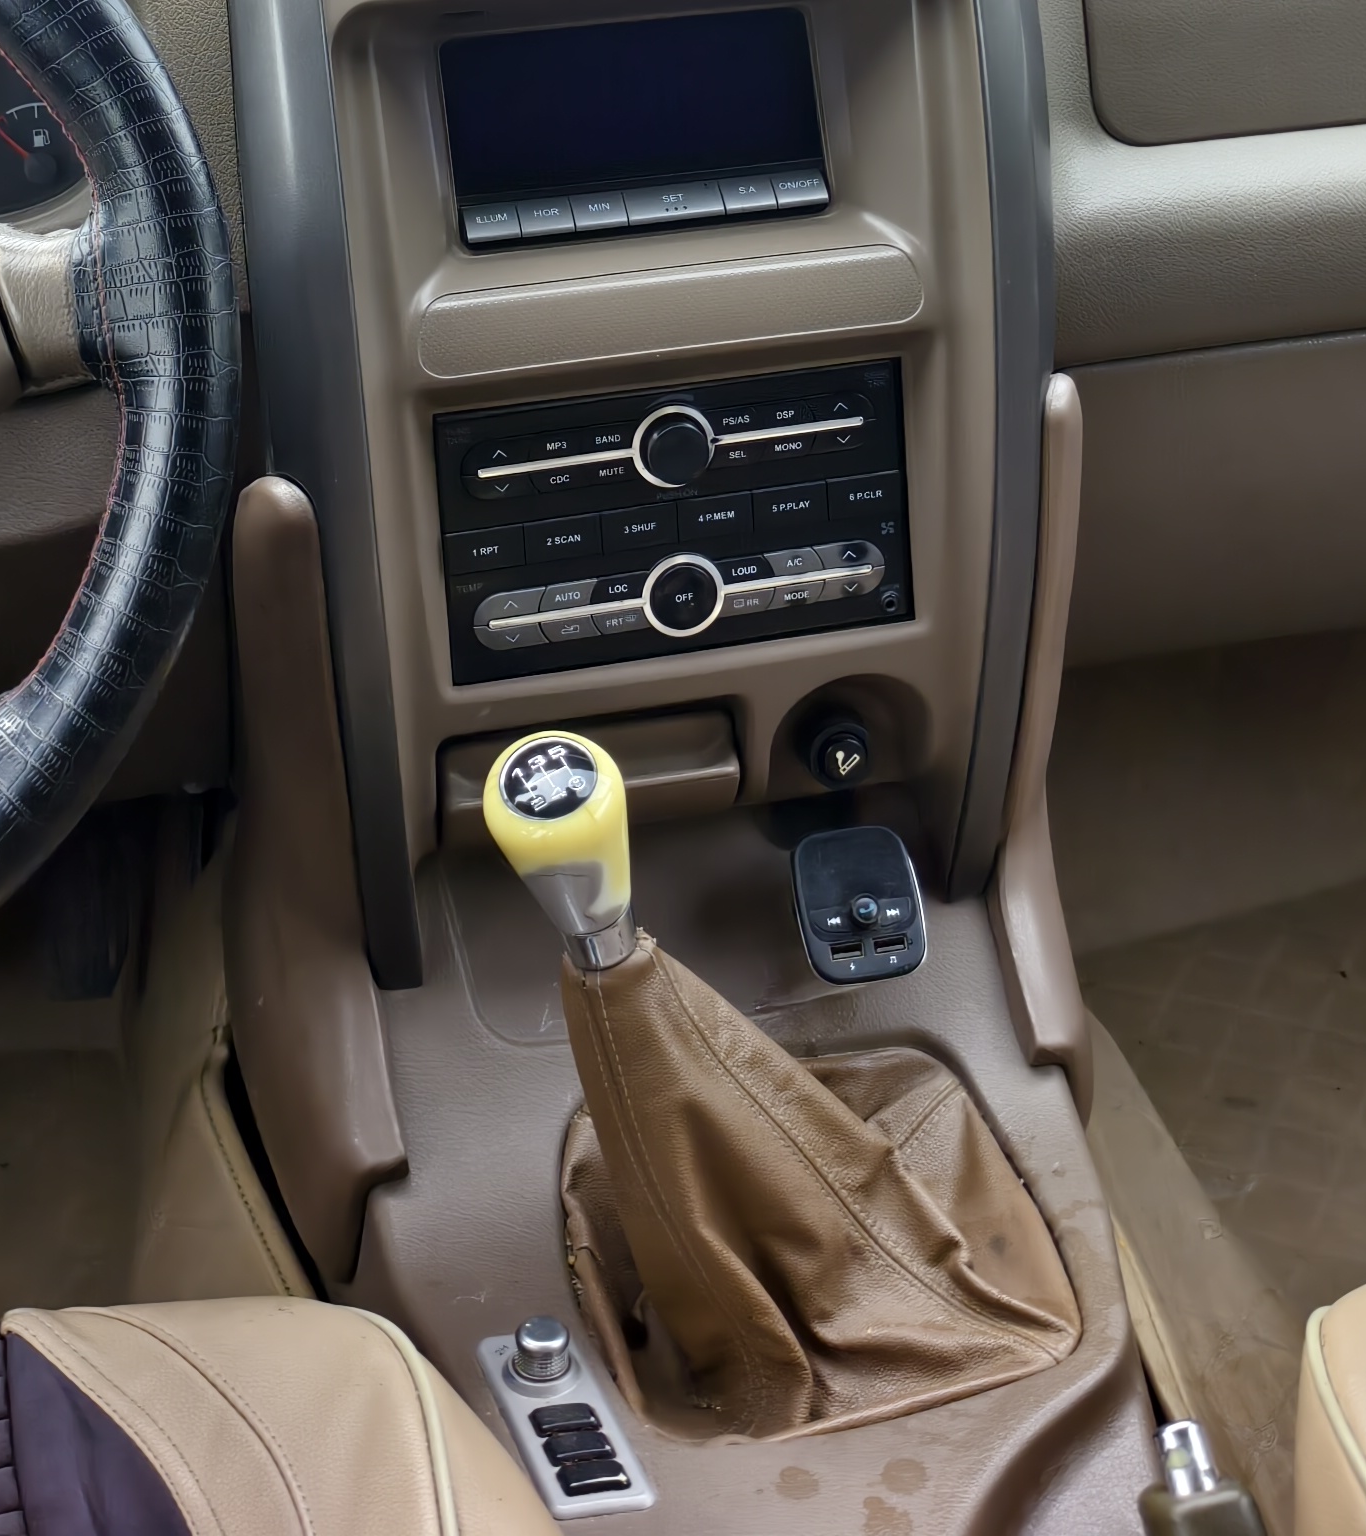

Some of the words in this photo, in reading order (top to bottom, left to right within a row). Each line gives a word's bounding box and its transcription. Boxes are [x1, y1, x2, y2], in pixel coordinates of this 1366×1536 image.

[778, 177, 820, 191] ON/OFF
[662, 192, 684, 204] SET
[534, 207, 560, 219] HOR
[588, 202, 610, 213] MIN
[475, 212, 508, 225] ILLUM
[722, 414, 750, 426] PS/AS
[595, 434, 621, 445] BAND
[546, 441, 567, 451] MP3
[774, 441, 803, 452] MONO
[728, 450, 747, 460] SEL
[598, 466, 626, 477] MUTE
[549, 474, 570, 485] CDC
[772, 504, 778, 512] 5
[698, 514, 704, 523] 4
[624, 525, 630, 534] 3
[631, 522, 657, 534] SHUF
[546, 537, 553, 546] 2
[554, 534, 581, 545] SCAN
[480, 545, 500, 556] RPT
[786, 557, 803, 568] A/C
[731, 565, 757, 577] LOUD
[608, 584, 629, 594] LOC
[554, 591, 581, 603] AUTO
[675, 592, 694, 603] OFF
[783, 590, 810, 602] MODE
[606, 617, 624, 628] FRT
[527, 754, 547, 770] 3
[547, 744, 567, 760] 5
